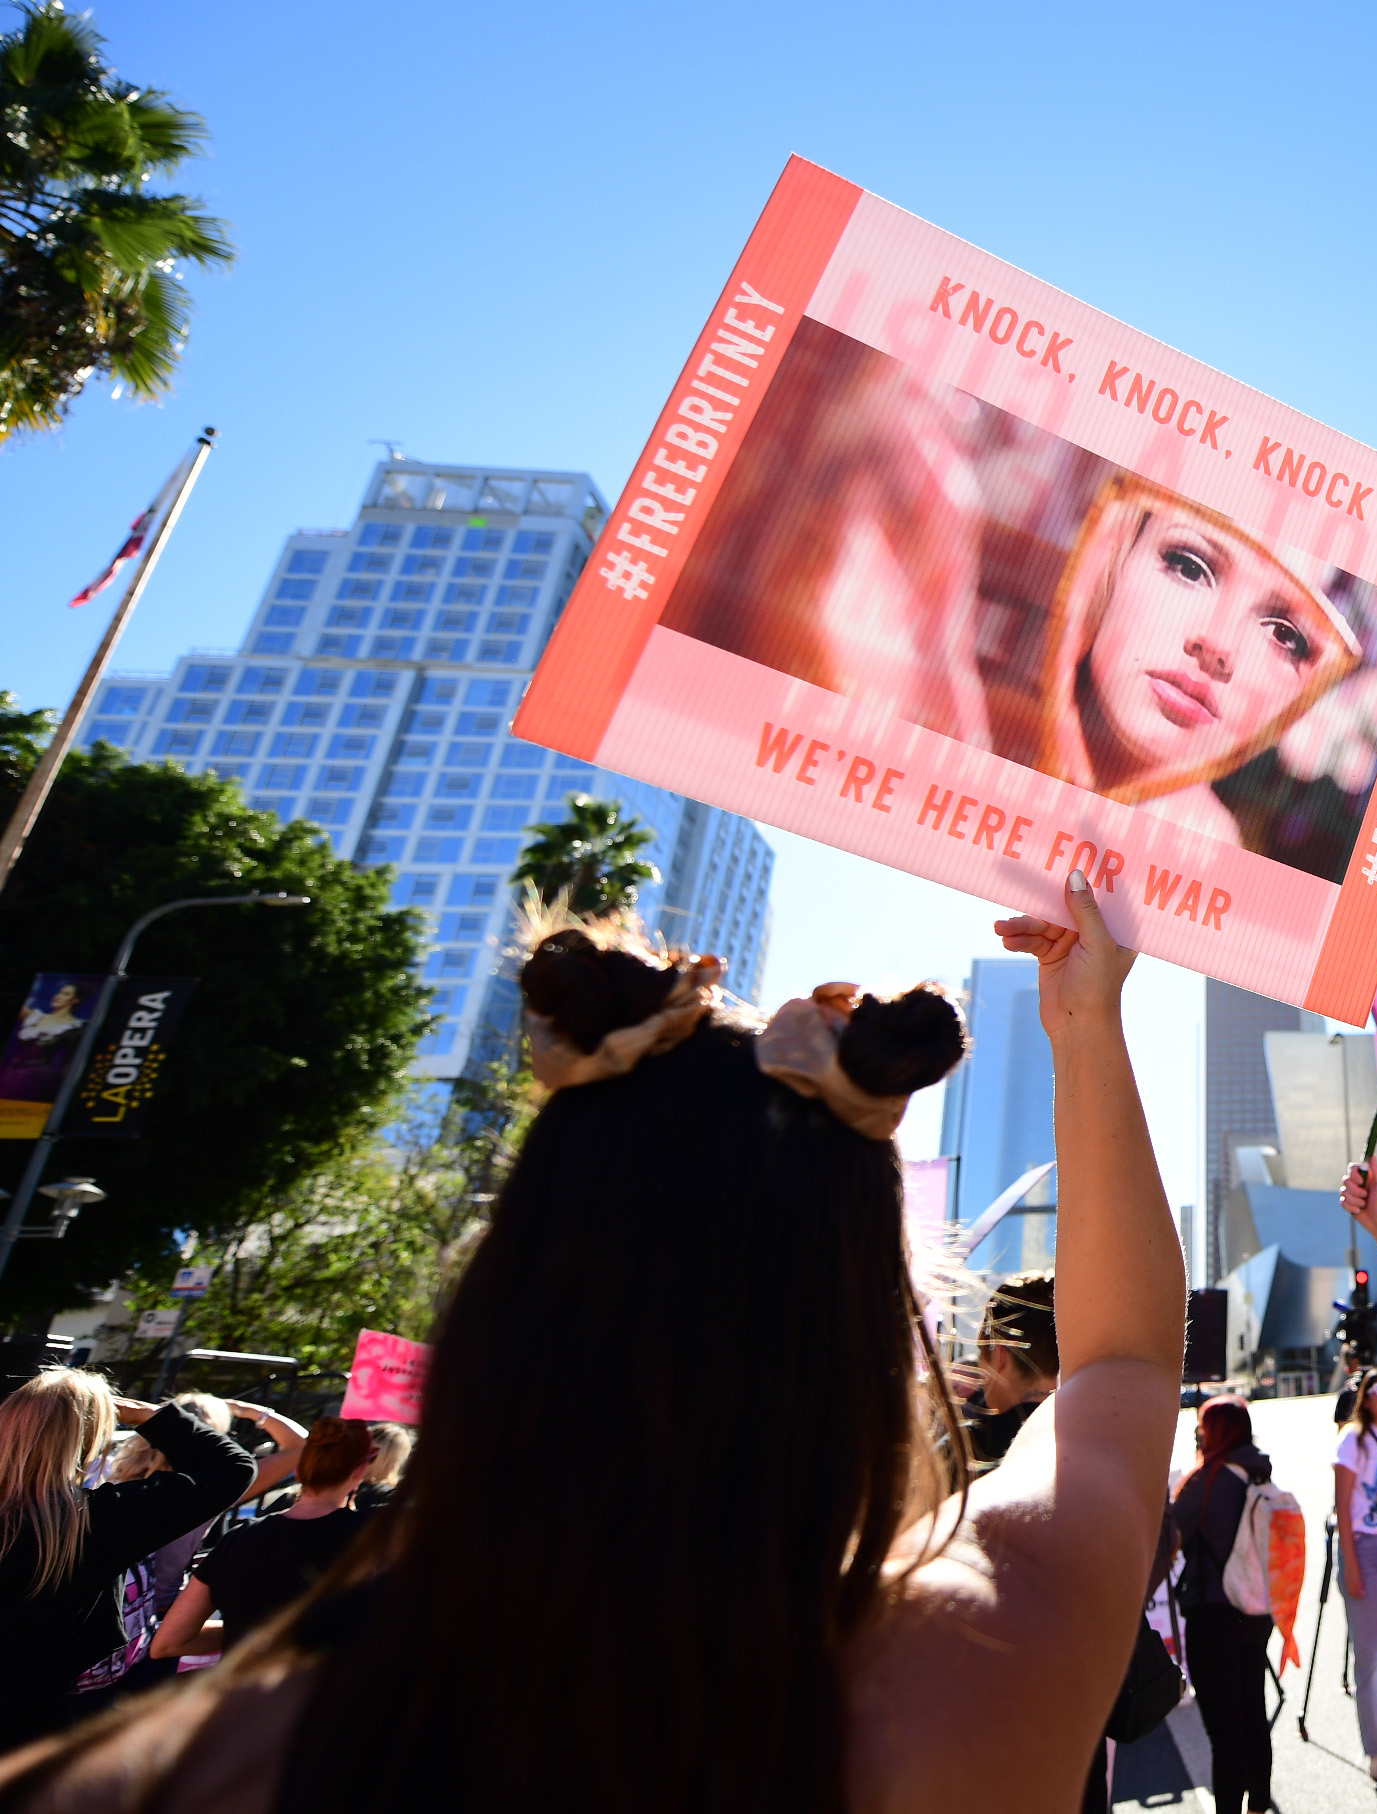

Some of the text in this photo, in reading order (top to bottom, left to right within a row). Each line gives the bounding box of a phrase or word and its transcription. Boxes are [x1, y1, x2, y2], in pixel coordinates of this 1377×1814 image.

[600, 281, 786, 600] #FREEBRITNEY
[929, 276, 1374, 522] KNOCK, KNOCK, KNOCK
[755, 722, 1232, 931] WE'RE HERE FOR WAR
